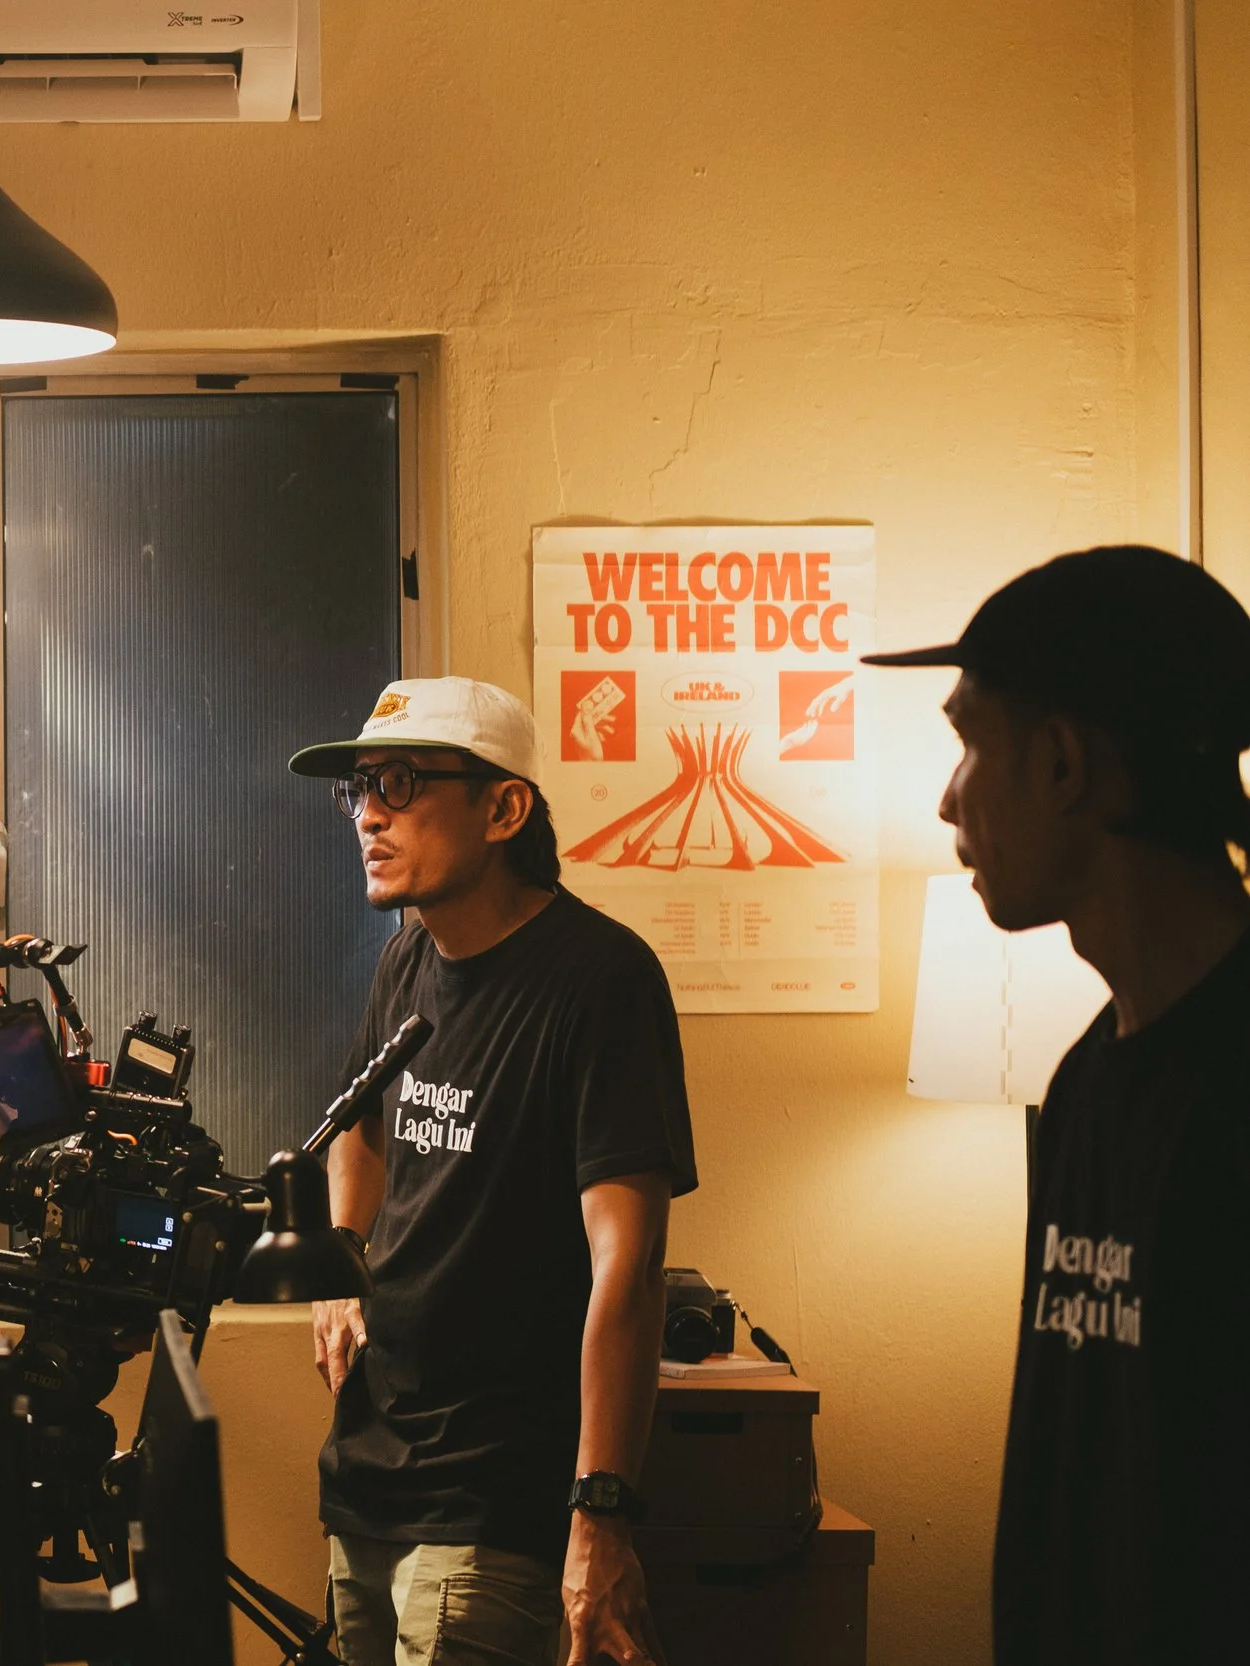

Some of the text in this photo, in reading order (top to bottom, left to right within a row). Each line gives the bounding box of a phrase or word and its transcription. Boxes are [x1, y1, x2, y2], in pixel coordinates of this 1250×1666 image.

[583, 552, 830, 602] WELCOME
[567, 603, 848, 653] TO THE DCC
[674, 691, 740, 701] IRELAND
[689, 682, 725, 691] UK &
[400, 1070, 473, 1120] Dengar
[394, 1107, 476, 1154] Lagu Ini
[1042, 1223, 1134, 1293] Dengar
[1034, 1282, 1108, 1350] Lagu
